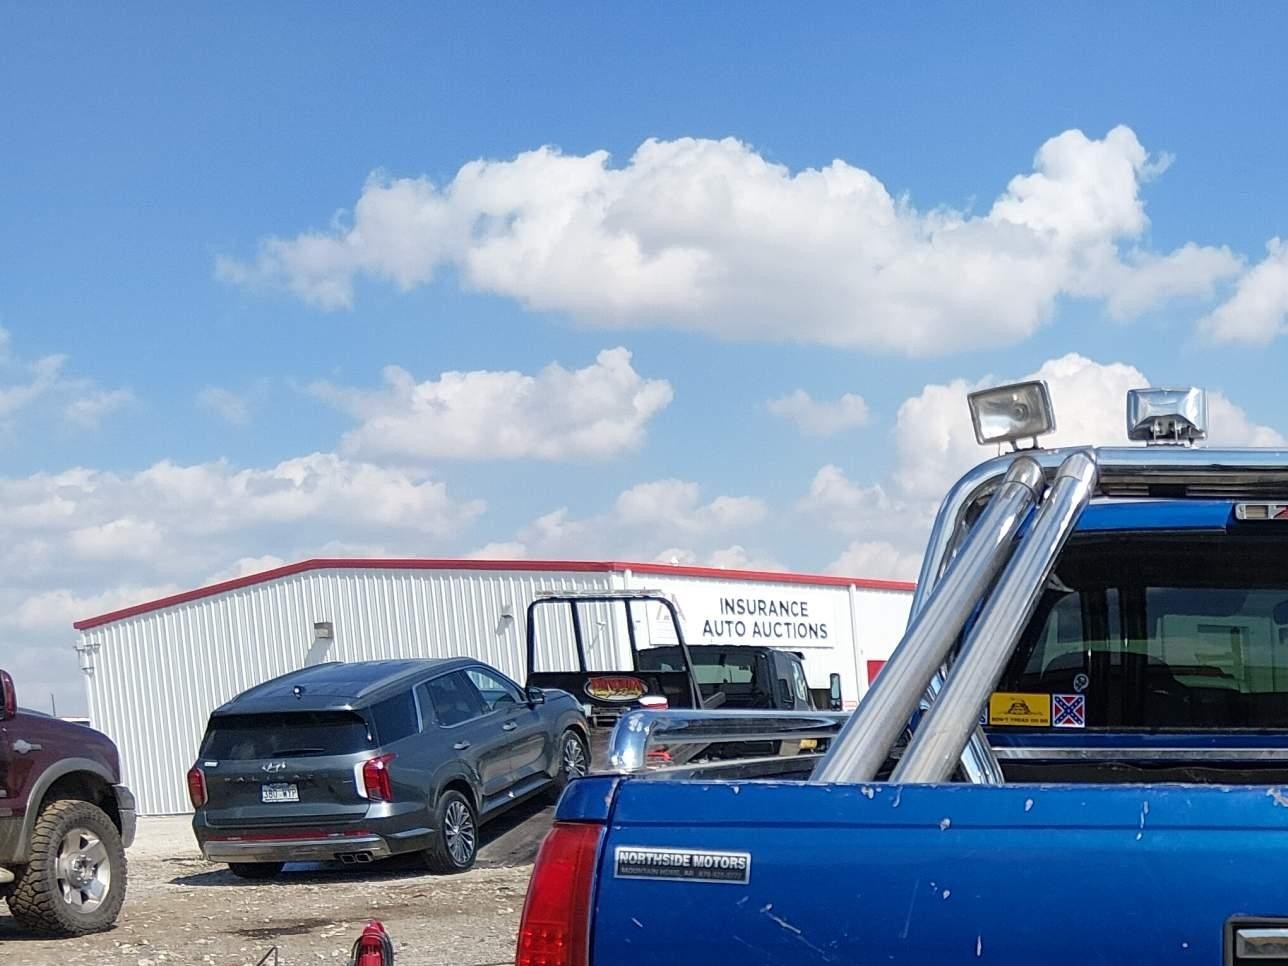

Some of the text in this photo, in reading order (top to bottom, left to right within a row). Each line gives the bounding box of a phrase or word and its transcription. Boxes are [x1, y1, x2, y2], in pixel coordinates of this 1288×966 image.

[719, 597, 809, 617] INSURANCE
[702, 619, 828, 639] AUTO AUCTIONS
[619, 851, 746, 870] NORTHSIDE MOTORS
